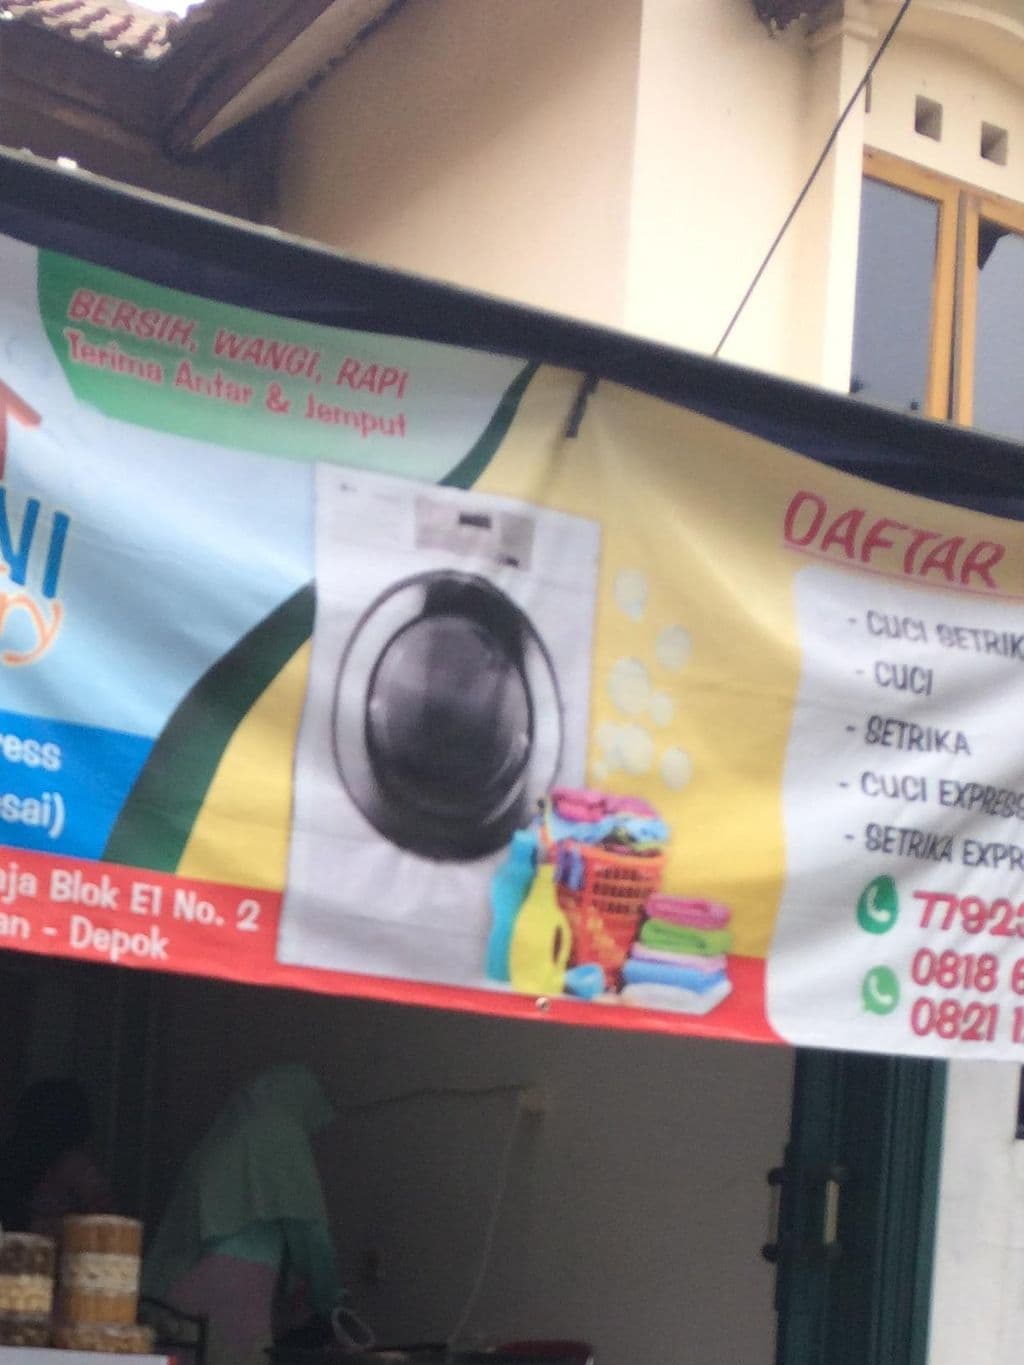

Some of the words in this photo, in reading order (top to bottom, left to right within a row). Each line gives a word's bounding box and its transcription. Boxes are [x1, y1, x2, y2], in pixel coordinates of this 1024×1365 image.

[68, 288, 197, 352] BERSIH,
[214, 329, 323, 385] WANGI,
[336, 356, 410, 399] RAPI
[64, 328, 163, 384] Terima
[174, 360, 253, 405] Antar
[266, 381, 292, 415] &
[304, 392, 408, 439] Jemput
[865, 609, 928, 644] CUCI
[874, 659, 934, 697] CUCI
[864, 714, 972, 756] SETRIKA
[860, 770, 928, 802] CUCI
[864, 822, 955, 863] SETRIKA
[49, 868, 120, 911] Blok
[173, 888, 225, 927] No.
[235, 898, 262, 932] 2
[69, 914, 170, 963] Depok
[911, 946, 999, 993] 0818
[910, 996, 1000, 1042] 0821
